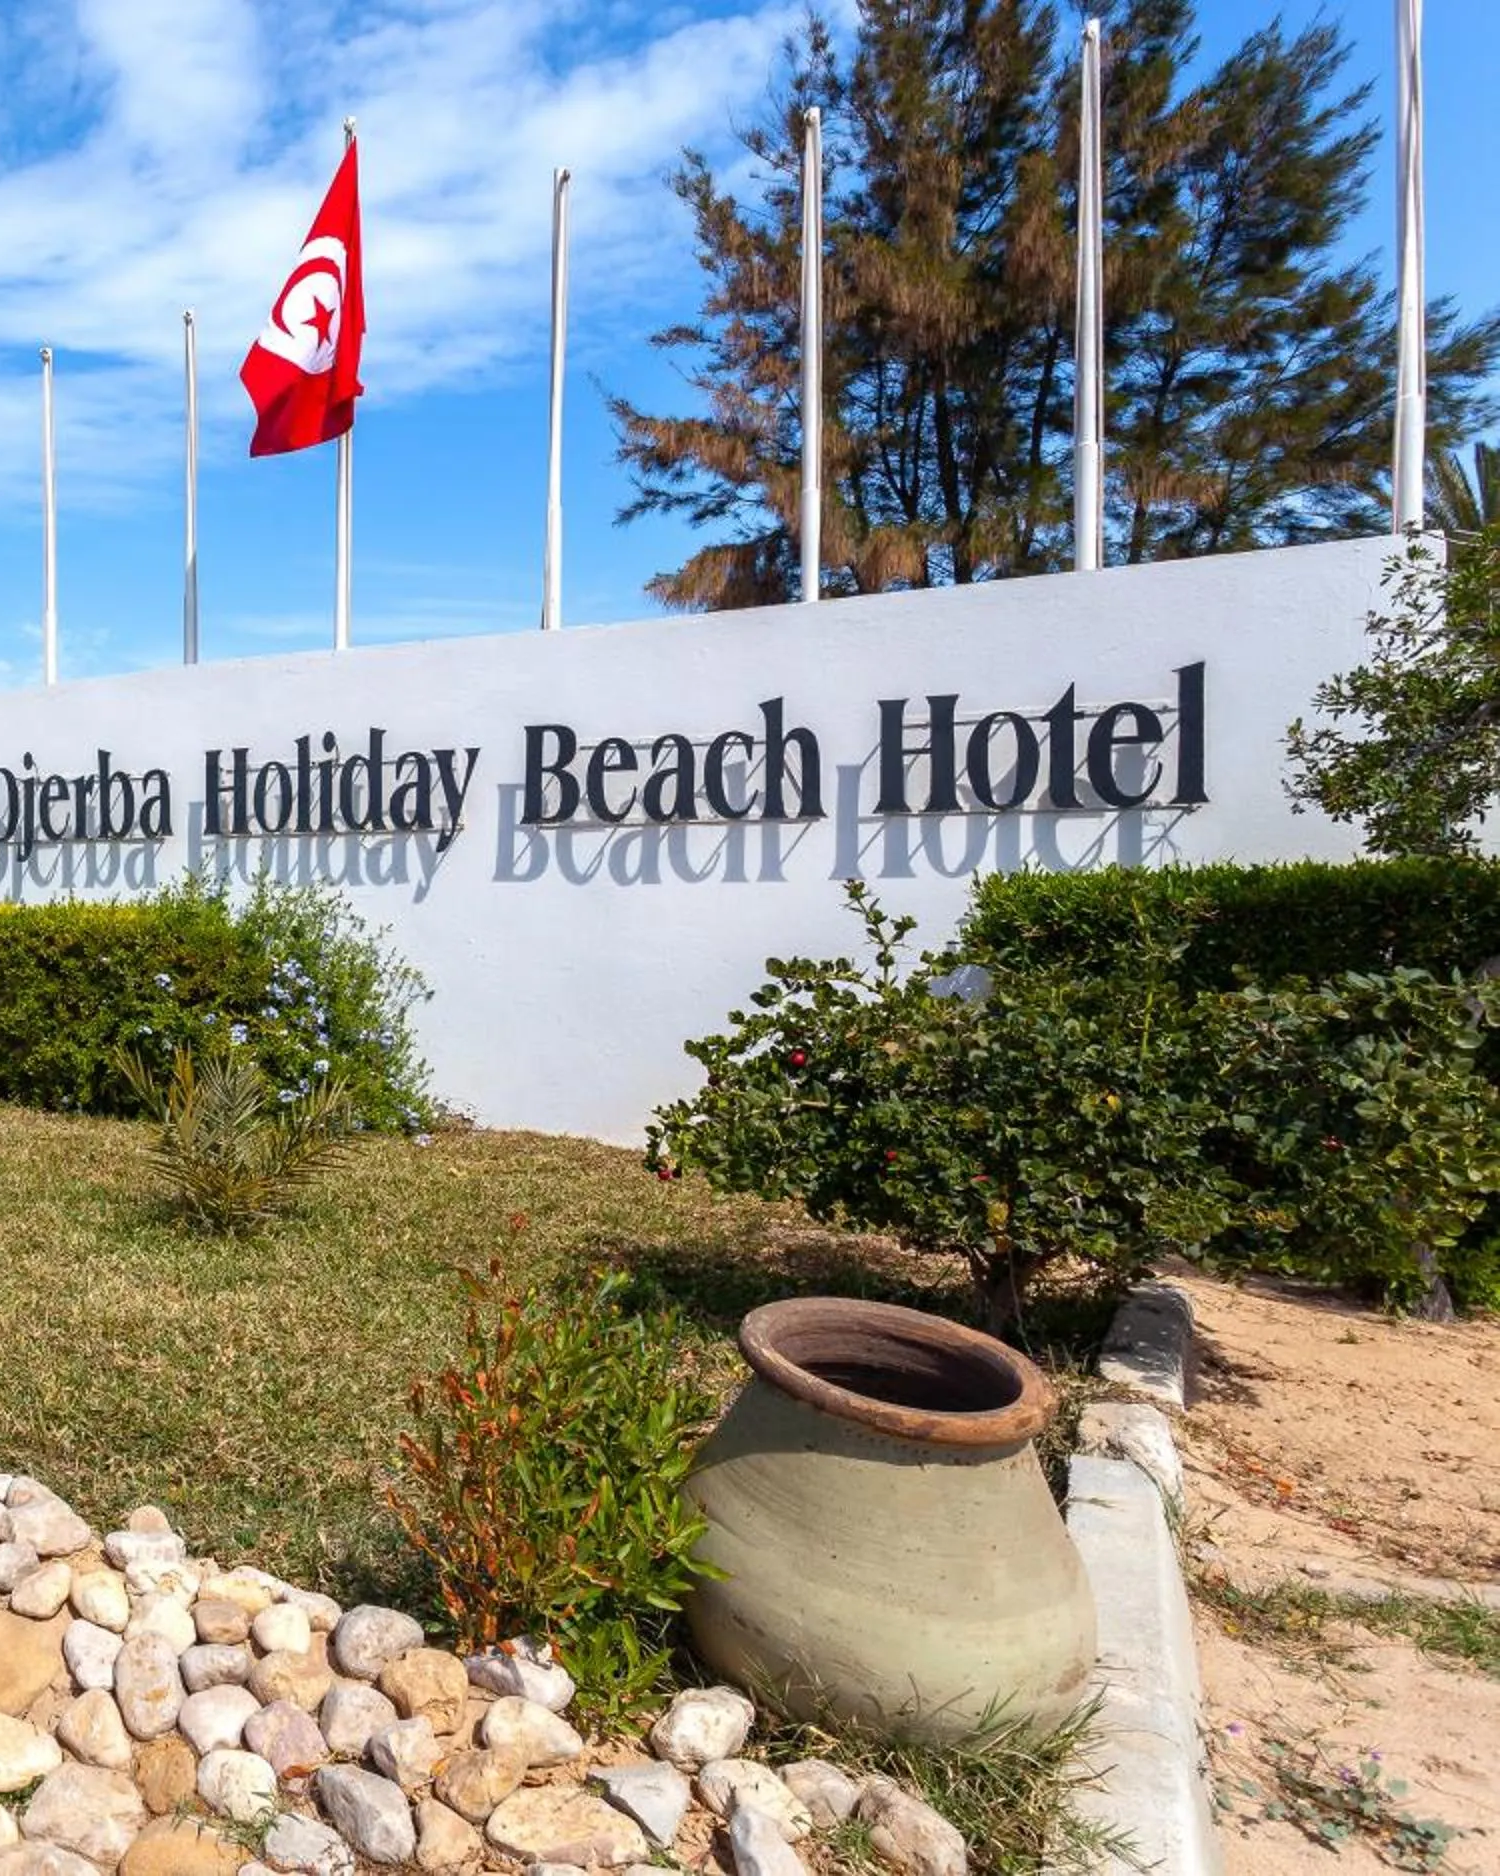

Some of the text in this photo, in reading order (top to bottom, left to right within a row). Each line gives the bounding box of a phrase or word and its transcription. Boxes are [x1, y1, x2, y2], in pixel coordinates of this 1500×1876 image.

[203, 727, 481, 853] Holiday
[520, 696, 827, 824] Beach
[872, 661, 1211, 813] Hotel
